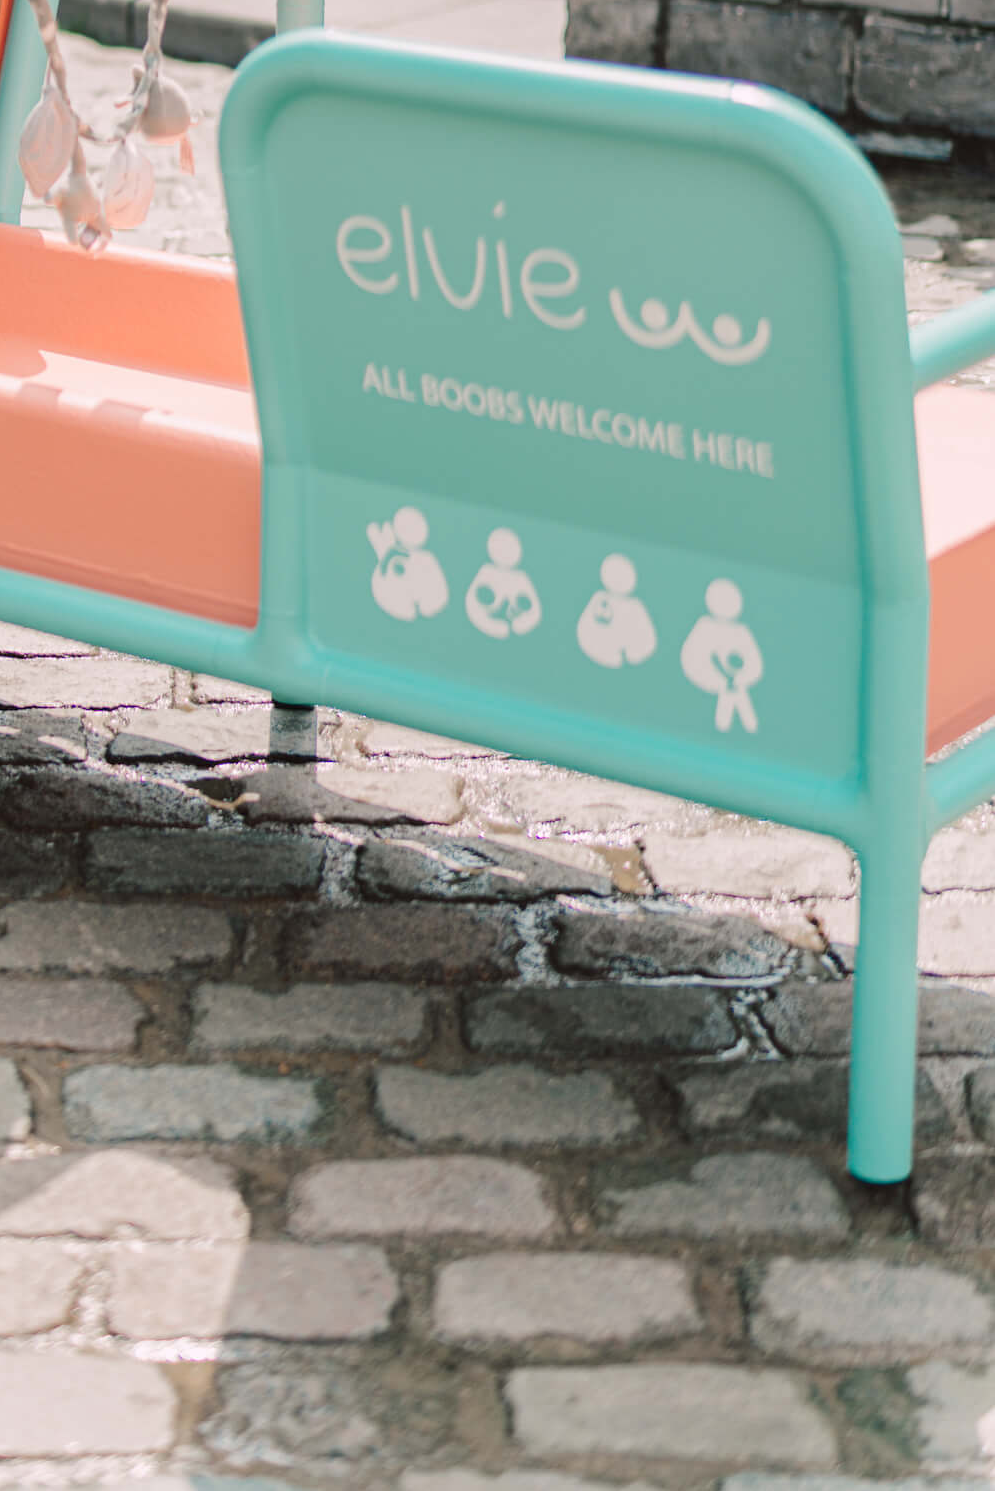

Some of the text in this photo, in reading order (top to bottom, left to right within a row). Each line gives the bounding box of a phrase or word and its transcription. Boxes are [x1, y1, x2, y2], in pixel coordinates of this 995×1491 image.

[336, 202, 586, 329] elvie
[363, 362, 775, 479] ALL BOOBS WELCOME HERE
